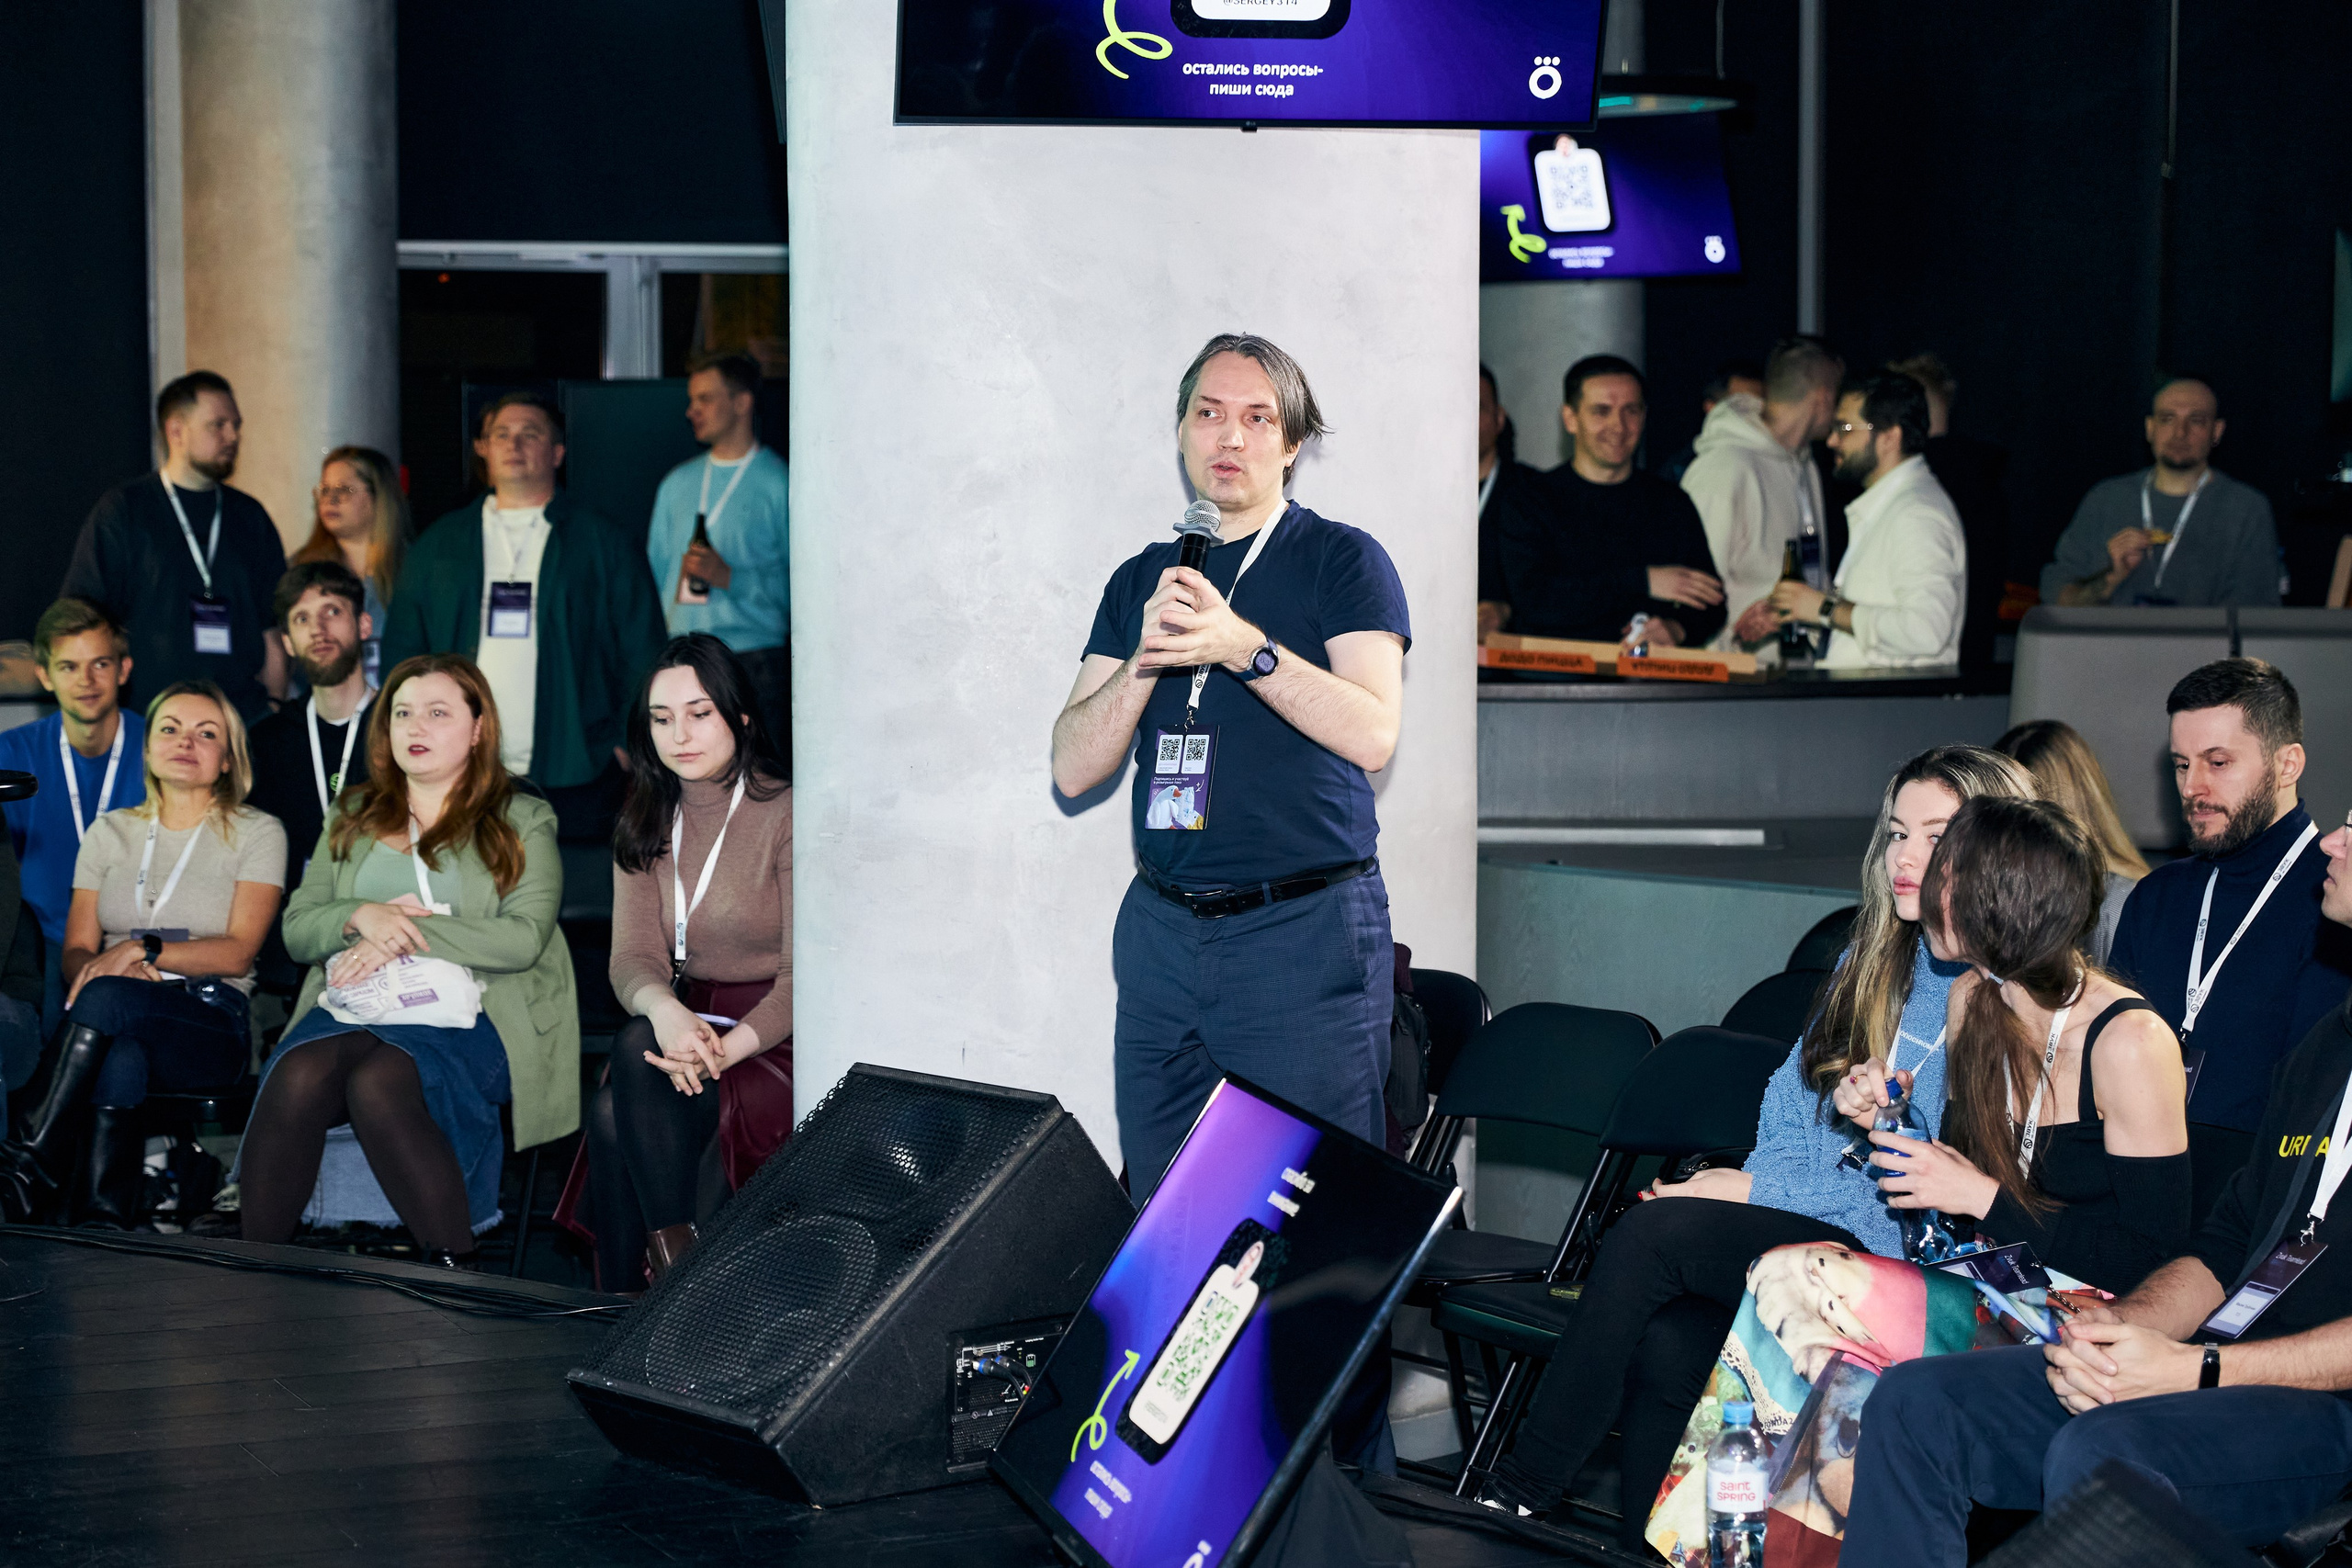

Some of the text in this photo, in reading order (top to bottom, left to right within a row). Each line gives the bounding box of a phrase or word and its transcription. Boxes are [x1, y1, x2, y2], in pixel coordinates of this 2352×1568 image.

[1182, 62, 1324, 79] остались вопросы-
[1209, 84, 1295, 98] пиши сюда
